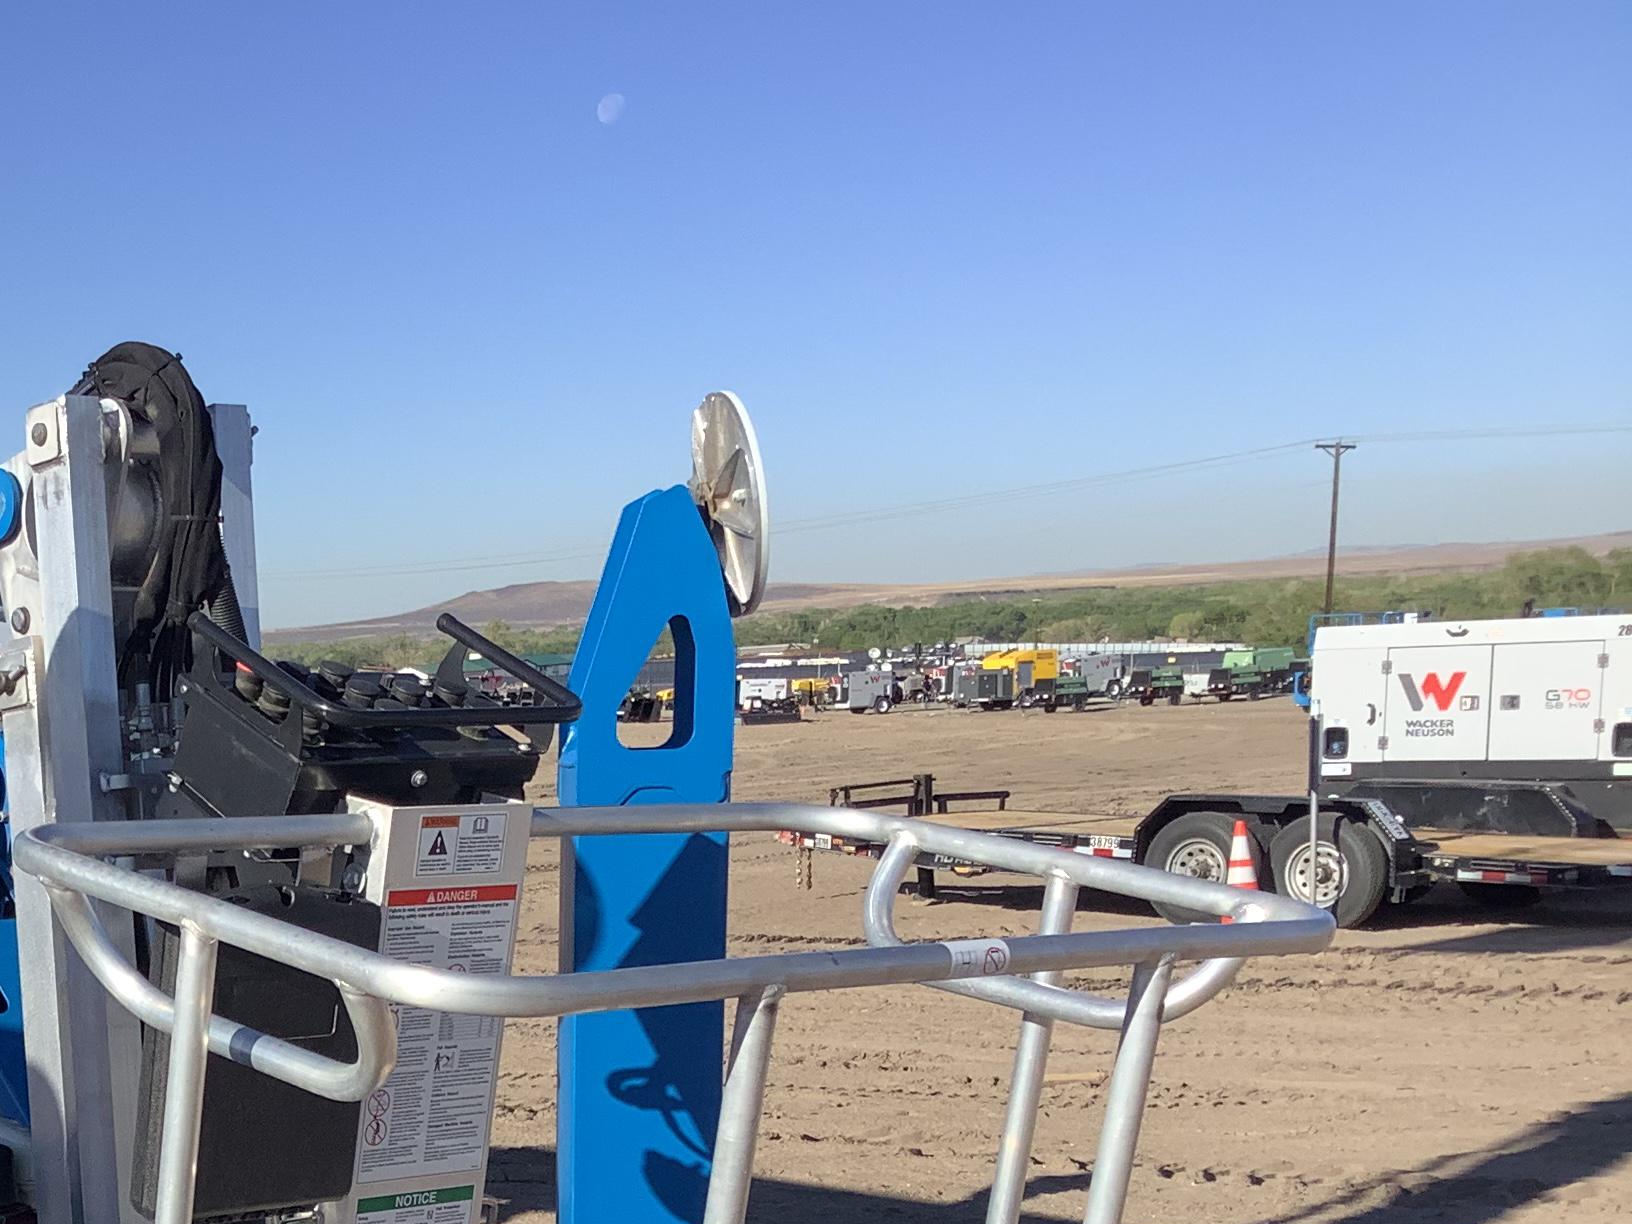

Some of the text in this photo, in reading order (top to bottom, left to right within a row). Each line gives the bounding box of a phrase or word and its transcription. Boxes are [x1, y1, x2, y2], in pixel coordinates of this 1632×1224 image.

[1405, 720, 1454, 728] WACKER
[1405, 728, 1454, 737] NEUSON
[437, 890, 478, 902] DANGER
[395, 1191, 437, 1207] NOTICE
